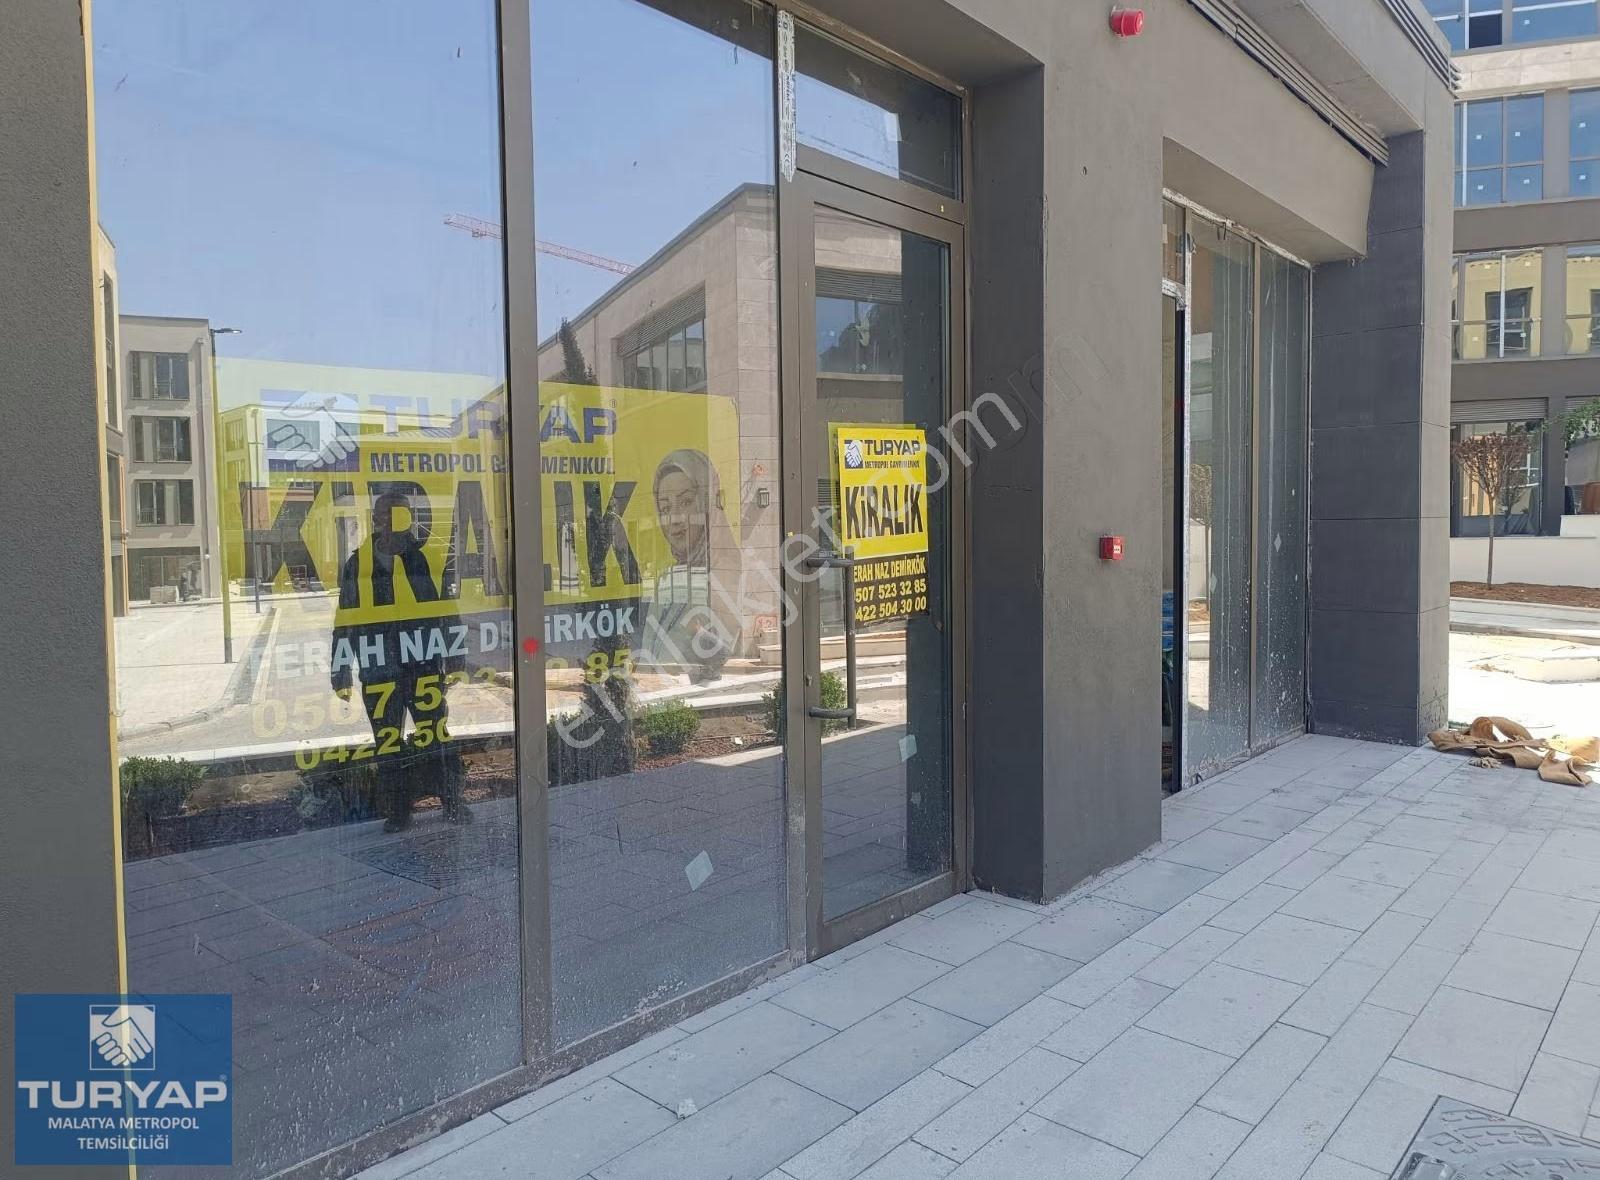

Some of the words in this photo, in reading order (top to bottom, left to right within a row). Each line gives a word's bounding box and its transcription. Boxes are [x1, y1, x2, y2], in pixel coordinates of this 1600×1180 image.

[370, 393, 617, 443] TURAP
[864, 439, 921, 456] TURYAP
[370, 452, 486, 474] METROPOL
[854, 563, 873, 583] ERAH
[875, 561, 890, 579] NAZ
[855, 585, 875, 603] 507
[878, 582, 897, 599] 523
[900, 580, 912, 596] 32
[914, 578, 927, 594] 85
[855, 604, 876, 622] 422
[879, 600, 898, 618] 504
[900, 598, 912, 614] 30
[915, 595, 927, 612] 00
[400, 624, 468, 664] NAZ
[584, 648, 635, 685] 85
